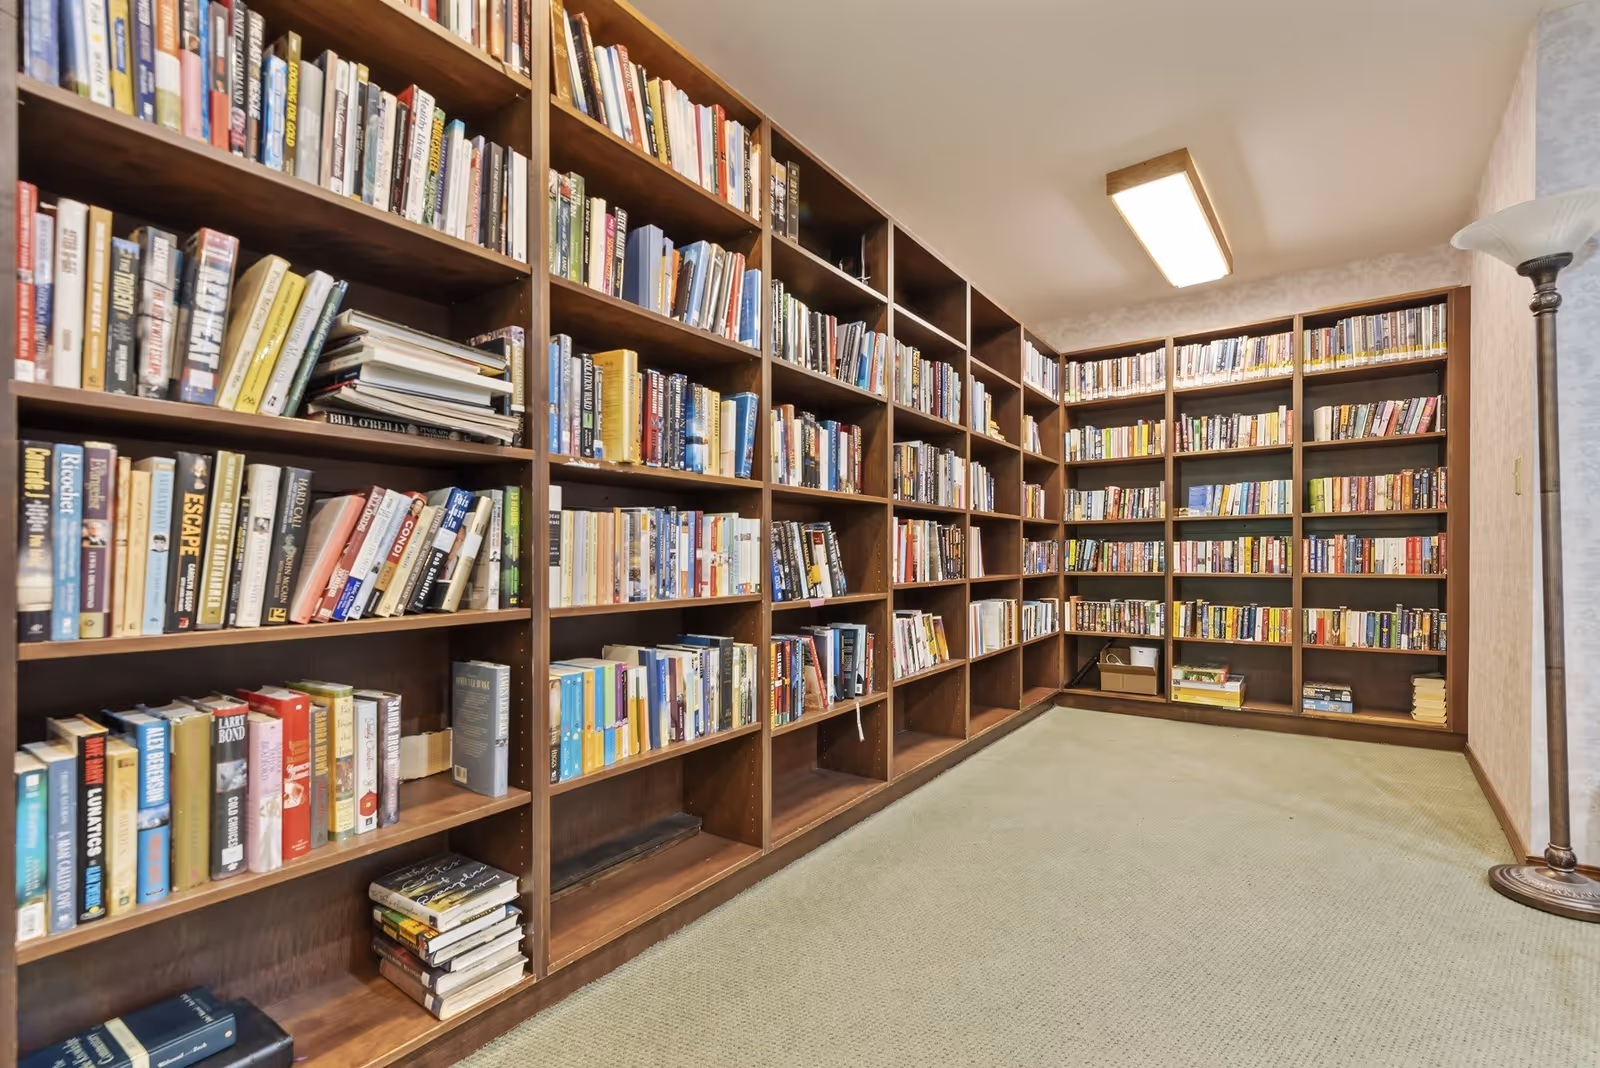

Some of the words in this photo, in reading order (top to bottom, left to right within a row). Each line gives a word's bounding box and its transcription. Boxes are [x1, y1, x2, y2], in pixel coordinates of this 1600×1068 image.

[251, 17, 263, 40] THE
[250, 38, 263, 67] LAST
[233, 51, 244, 105] COMMAND
[287, 62, 299, 103] LOOKING
[287, 102, 297, 122] FOR
[416, 95, 430, 131] Healthy
[286, 121, 296, 148] GOLD
[413, 133, 427, 162] Living
[428, 118, 444, 174] SMOKESCREEN
[617, 210, 627, 231] STEVE
[616, 230, 626, 259] MARTINI
[119, 258, 130, 272] THE
[112, 271, 135, 315] TRIDENT
[196, 266, 230, 312] RED
[290, 305, 315, 344] Inventing
[187, 310, 224, 370] HEAT
[147, 347, 162, 378] ESCAPE
[583, 358, 593, 392] ISOLATION
[584, 391, 592, 410] WARD
[330, 413, 357, 427] BILL
[359, 418, 408, 433] O'REILLY
[24, 447, 51, 491] Comrade
[60, 452, 82, 514] Ricochet
[84, 458, 107, 510] Evangelist
[295, 477, 309, 506] HARD
[511, 491, 519, 501] 13
[455, 491, 470, 507] This
[179, 492, 205, 557] ESCAPE
[215, 502, 234, 540] CHARLES
[290, 506, 304, 530] CALL
[357, 508, 374, 532] ODDS
[429, 508, 444, 534] POITIER
[510, 501, 519, 527] HOURS
[392, 520, 414, 558] CONDI
[284, 554, 294, 575] JOHN
[415, 550, 429, 573] MEASURE
[431, 552, 443, 566] Bob
[185, 563, 196, 590] CAROLYN
[206, 544, 230, 609] KRAUTHAMMER
[380, 566, 393, 585] FELIX
[418, 567, 437, 601] Schieffer
[184, 590, 194, 612] JESSOP
[279, 576, 292, 604] McCAIN
[402, 586, 412, 599] MAN
[499, 671, 510, 697] JAMES
[387, 700, 401, 735] SANDRA
[498, 697, 509, 713] LEE
[218, 715, 245, 729] LARRY
[218, 727, 245, 743] BOND
[315, 711, 328, 745] SANDRA
[498, 713, 508, 737] BURKE
[85, 736, 104, 758] DAVE
[146, 727, 164, 752] ALEX
[387, 735, 400, 765] BROWN
[85, 758, 104, 785] BARRY
[315, 746, 329, 776] BROWN
[145, 751, 165, 803] BERENSON
[227, 796, 239, 816] COLD
[87, 787, 104, 857] LUNATICS
[227, 816, 239, 848] CHOICES
[56, 839, 71, 858] MAN
[57, 860, 71, 891] CALLED
[85, 865, 101, 883] ALAN
[57, 892, 72, 909] OVE
